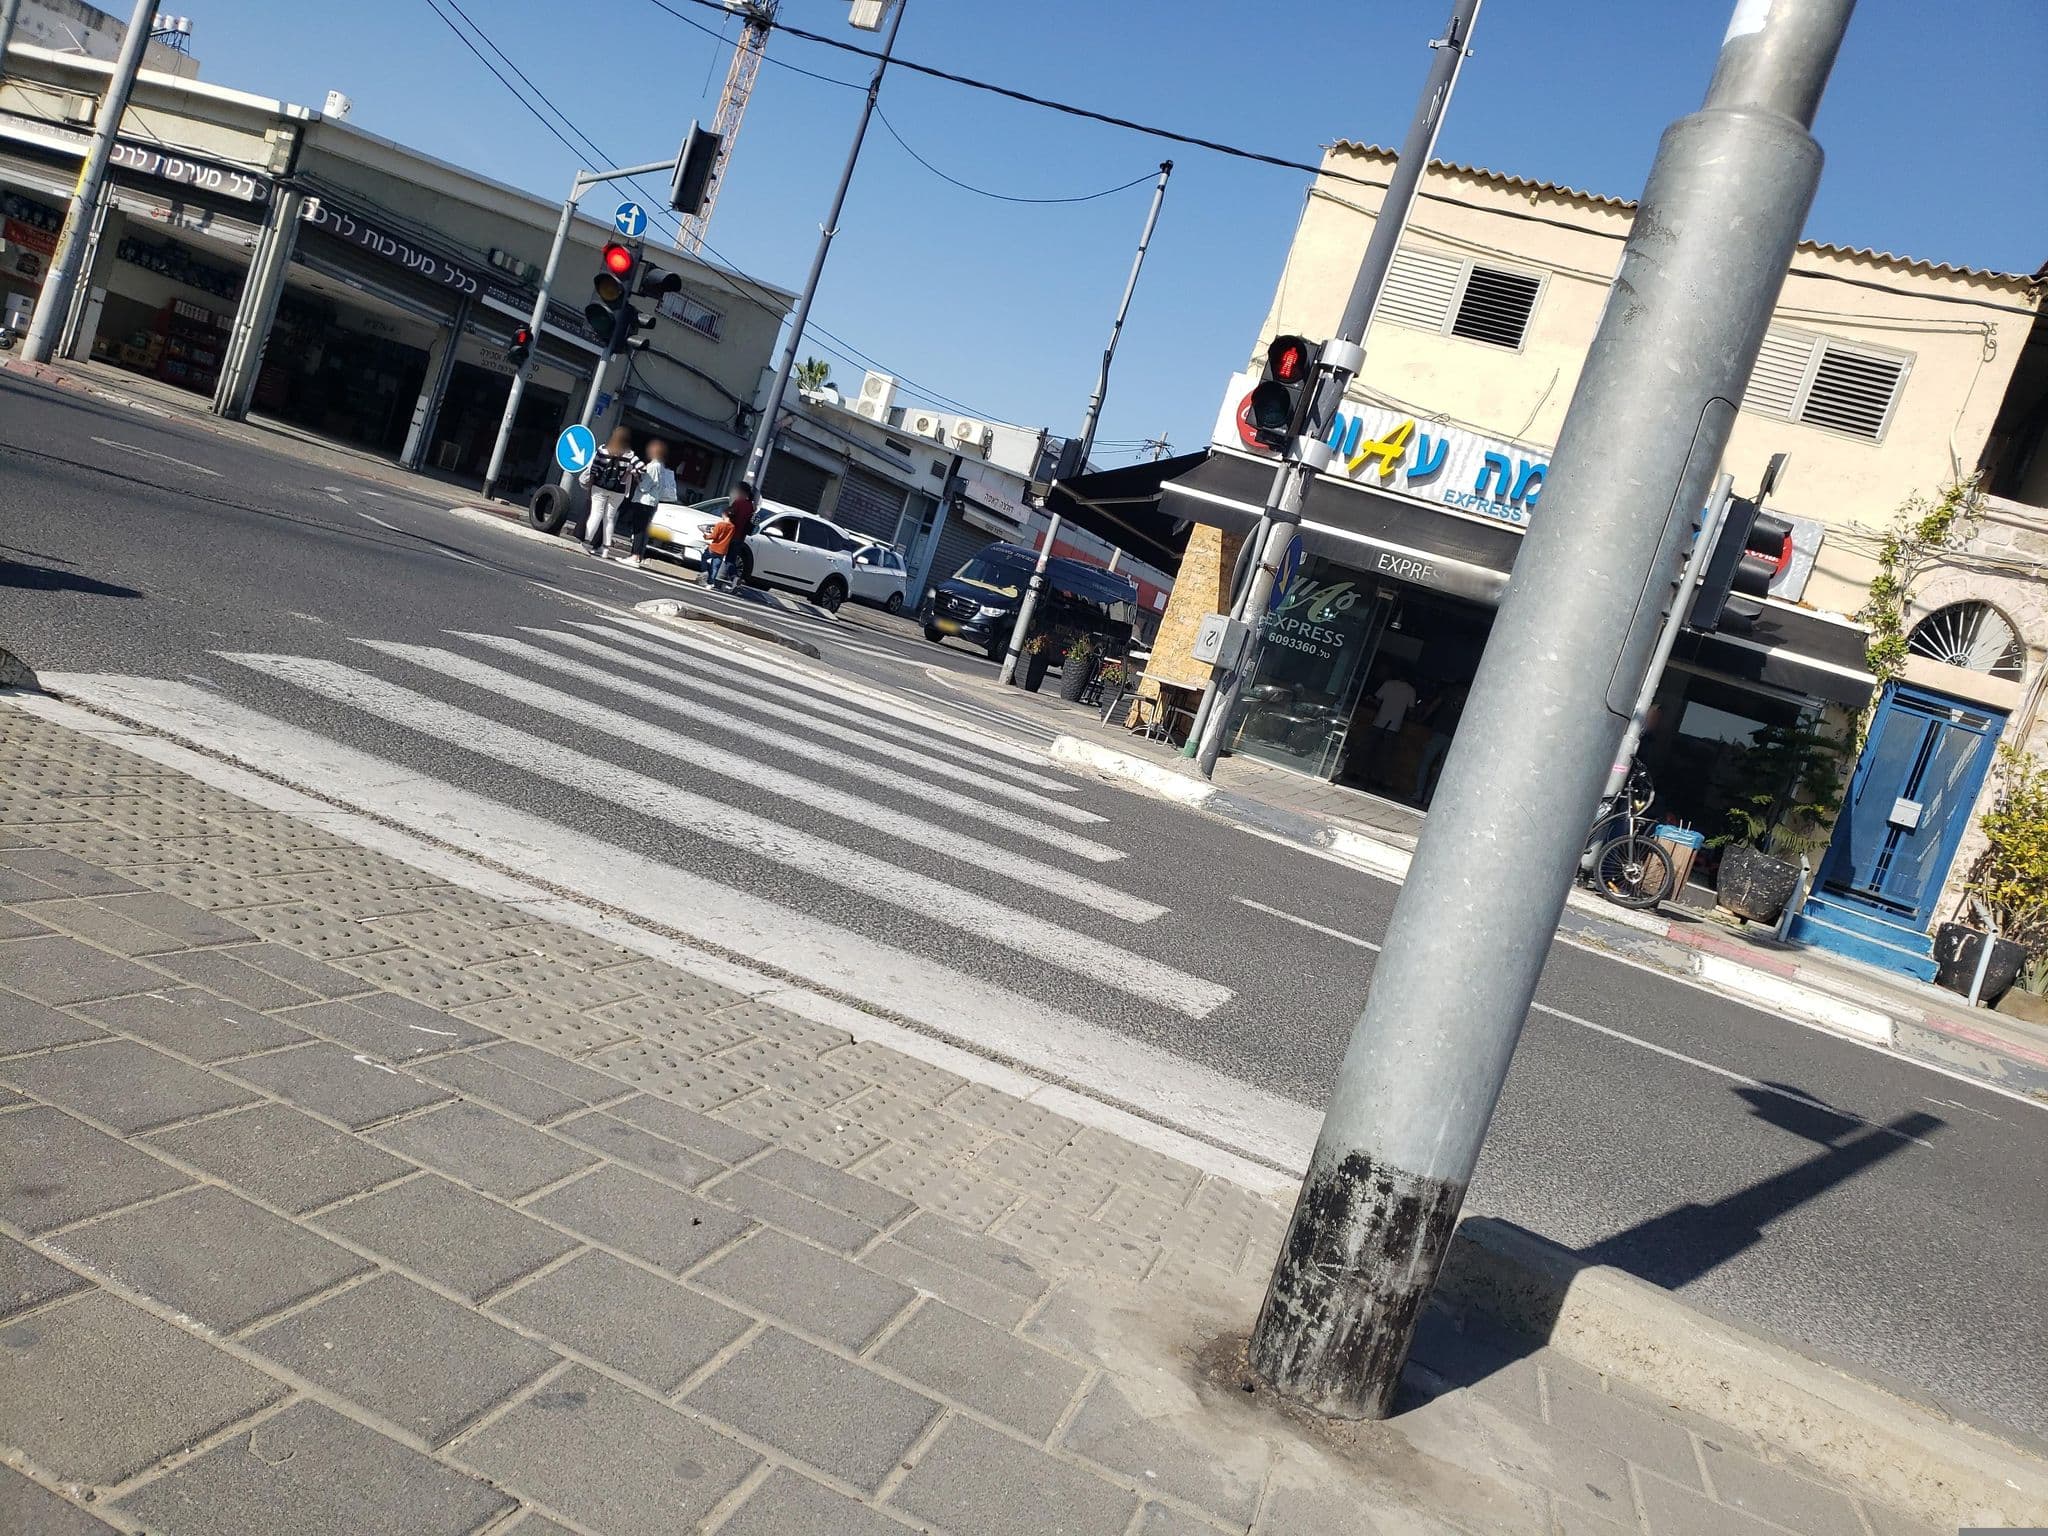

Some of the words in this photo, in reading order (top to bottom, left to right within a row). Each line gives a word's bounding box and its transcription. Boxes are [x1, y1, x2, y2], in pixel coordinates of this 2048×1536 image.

[109, 142, 148, 166] לרכ
[151, 154, 222, 187] מערכות
[361, 228, 436, 276] מערכות
[444, 263, 477, 294] כלל
[1442, 488, 1523, 522] EXPRESS
[1265, 611, 1345, 647] EXPRESS
[1268, 632, 1317, 656] 6093360
